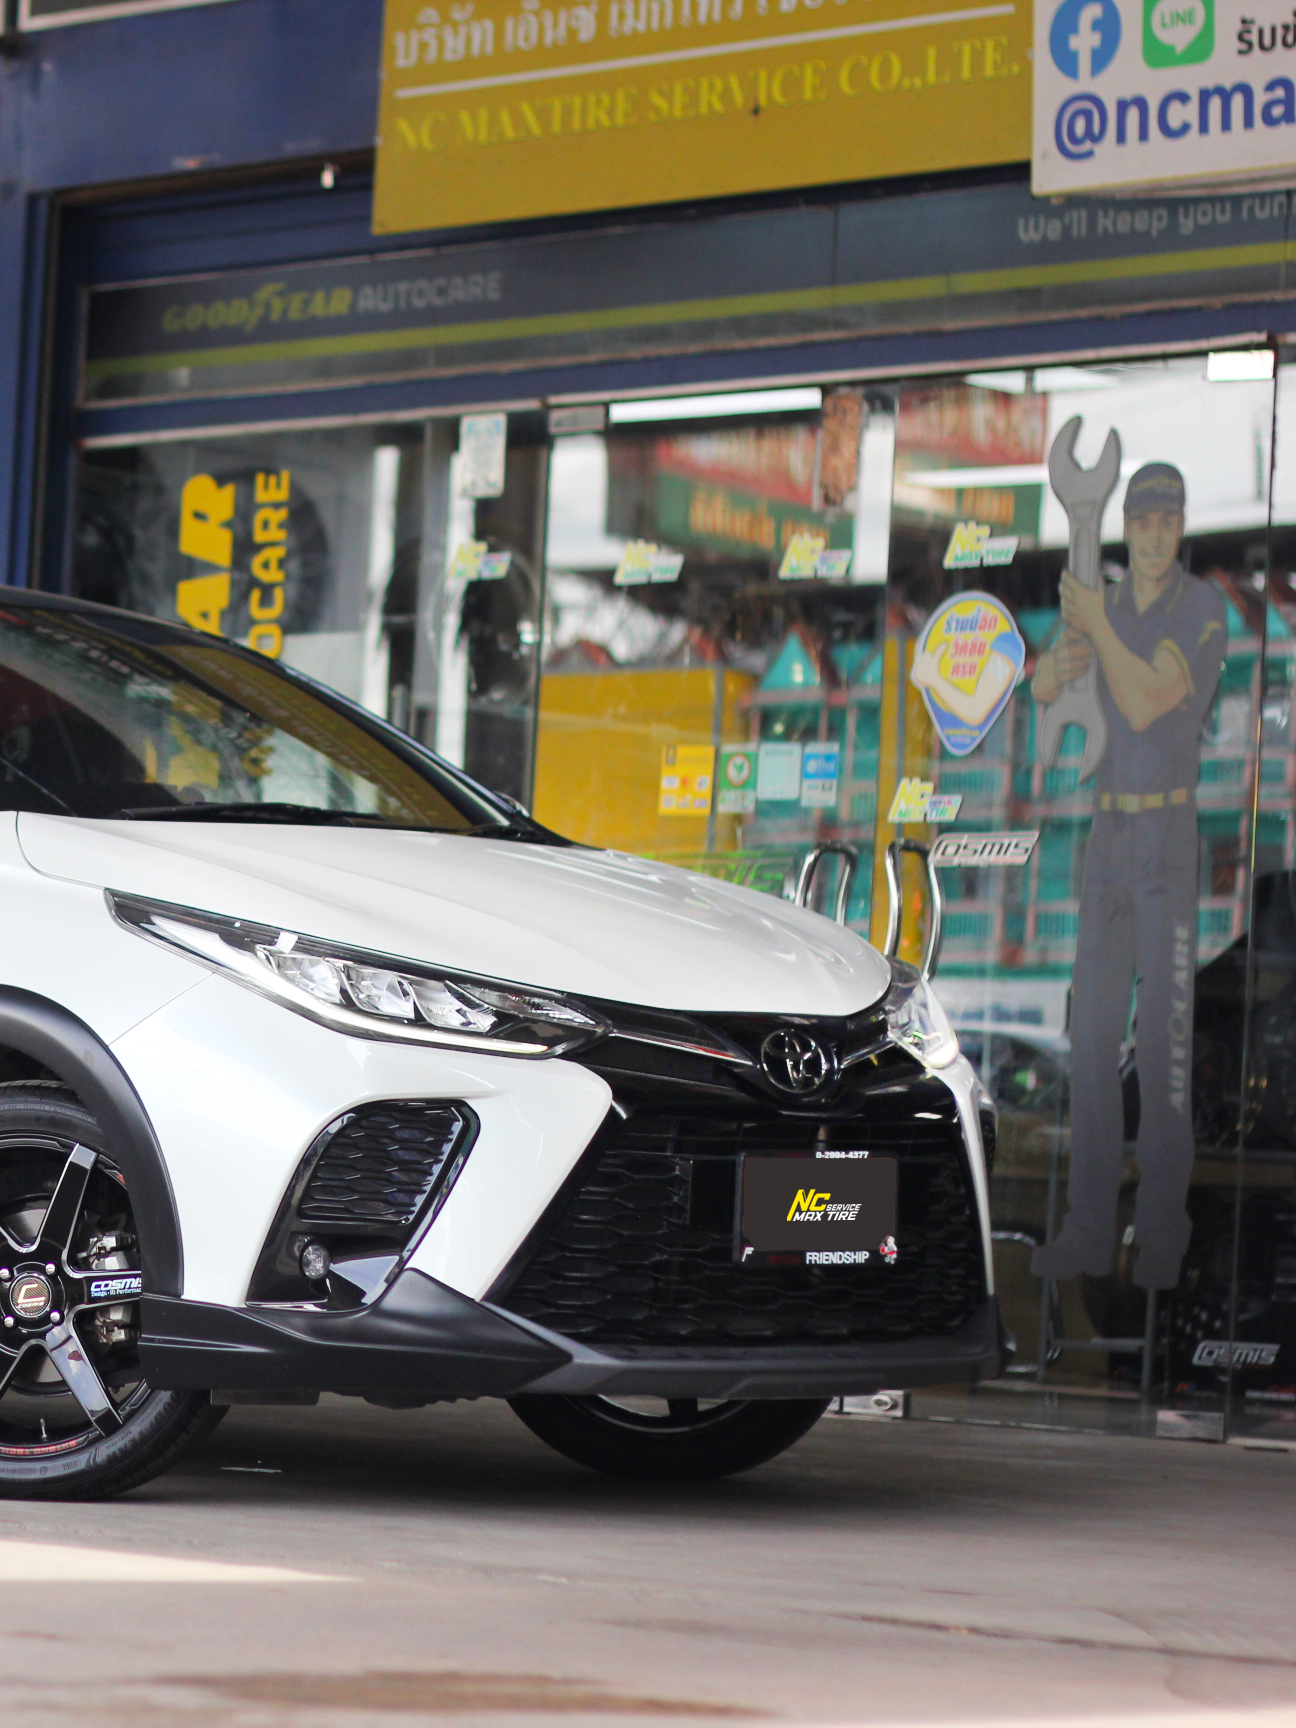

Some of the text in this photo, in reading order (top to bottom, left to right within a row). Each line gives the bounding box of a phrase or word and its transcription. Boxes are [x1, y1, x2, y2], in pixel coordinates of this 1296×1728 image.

[1161, 7, 1197, 30] LINE
[396, 112, 448, 151] NC
[647, 59, 827, 122] SERVICE
[1018, 209, 1088, 243] We'll
[1178, 202, 1233, 236] you
[162, 272, 503, 333] GOODYEAR AUTOCARE
[945, 521, 991, 568] NC
[888, 778, 934, 821] NC
[929, 832, 1039, 866] COSMIS
[805, 1250, 870, 1264] FRIENDSHIP
[91, 1277, 142, 1292] COSMI
